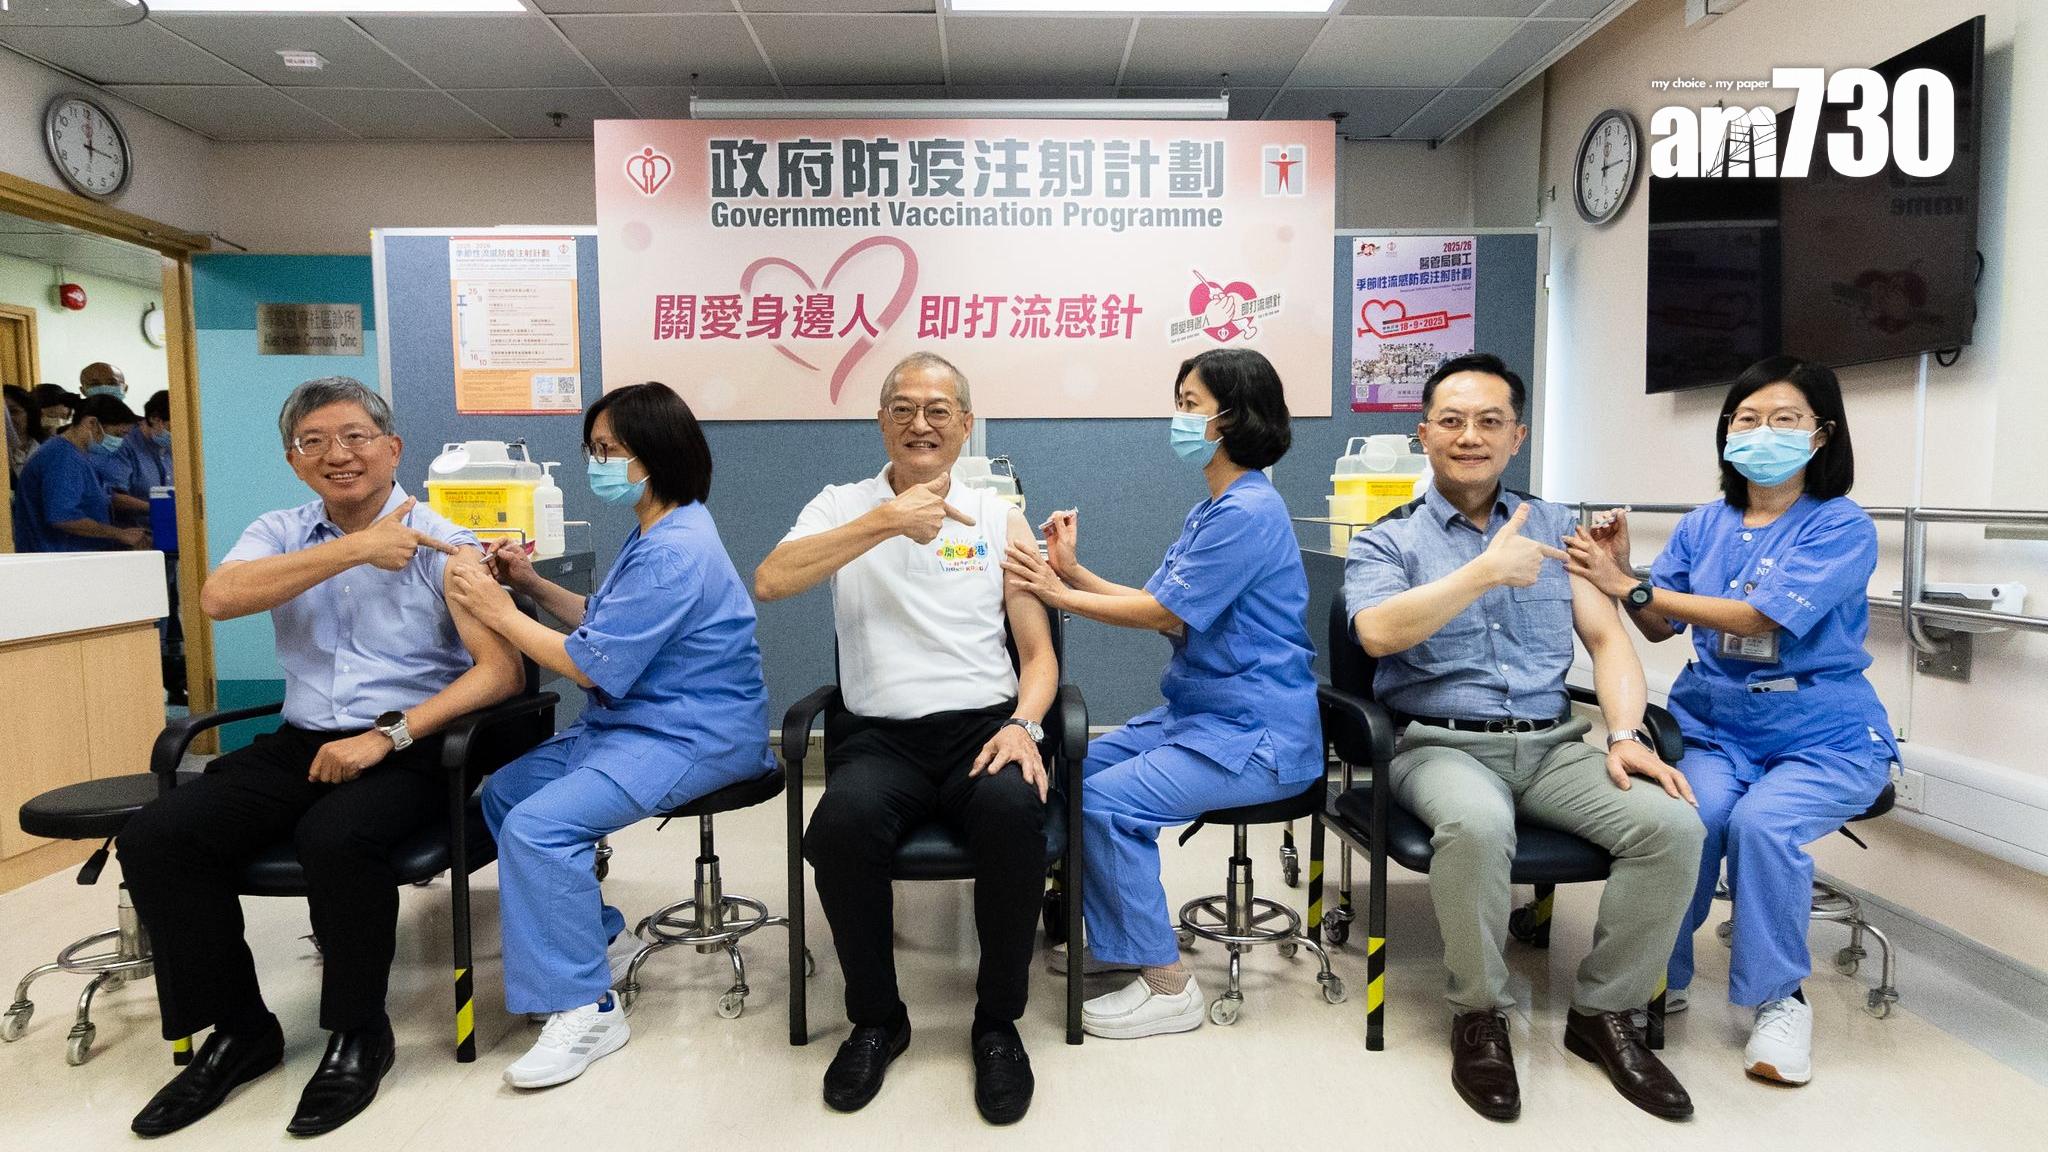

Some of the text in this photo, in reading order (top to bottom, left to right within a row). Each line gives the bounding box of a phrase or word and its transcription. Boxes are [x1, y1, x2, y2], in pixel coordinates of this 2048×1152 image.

[710, 138, 1224, 198] 政府防疫注射計劃
[711, 201, 1223, 232] Government Vaccination Programme
[653, 293, 1143, 341] 關愛身邊人 即打流感針
